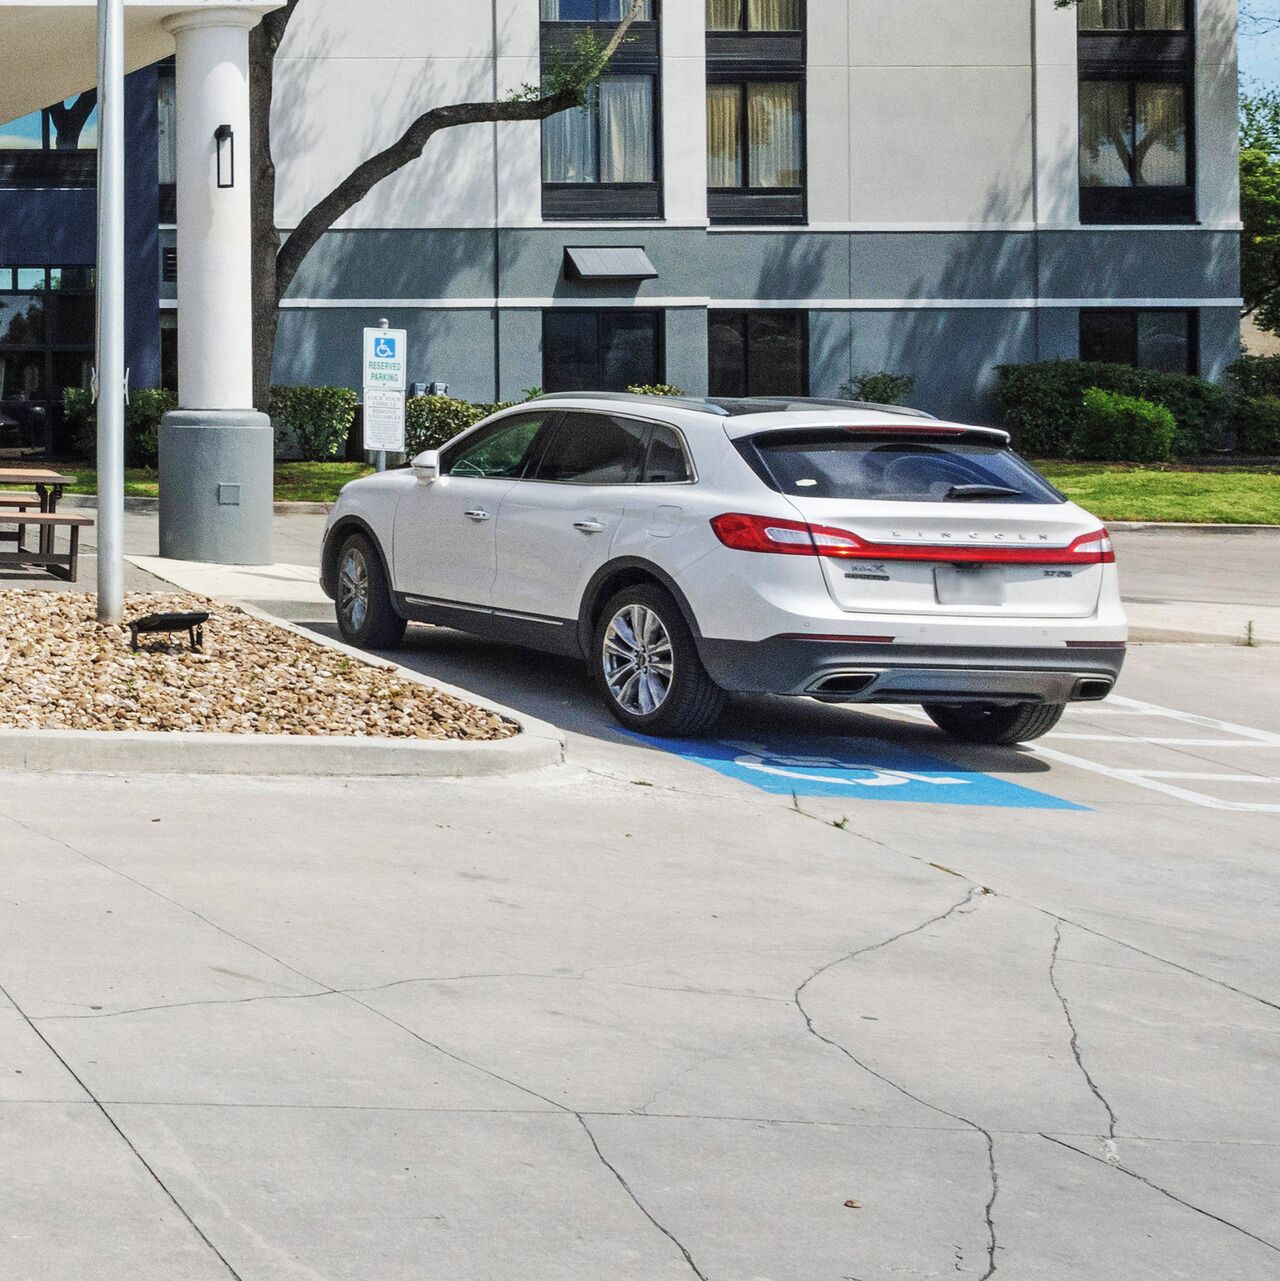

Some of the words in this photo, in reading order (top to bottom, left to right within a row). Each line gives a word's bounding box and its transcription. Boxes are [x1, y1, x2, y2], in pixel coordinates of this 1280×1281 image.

[368, 361, 401, 371] RESERVED
[370, 372, 399, 382] PARKING
[891, 528, 1048, 540] LINCOLN
